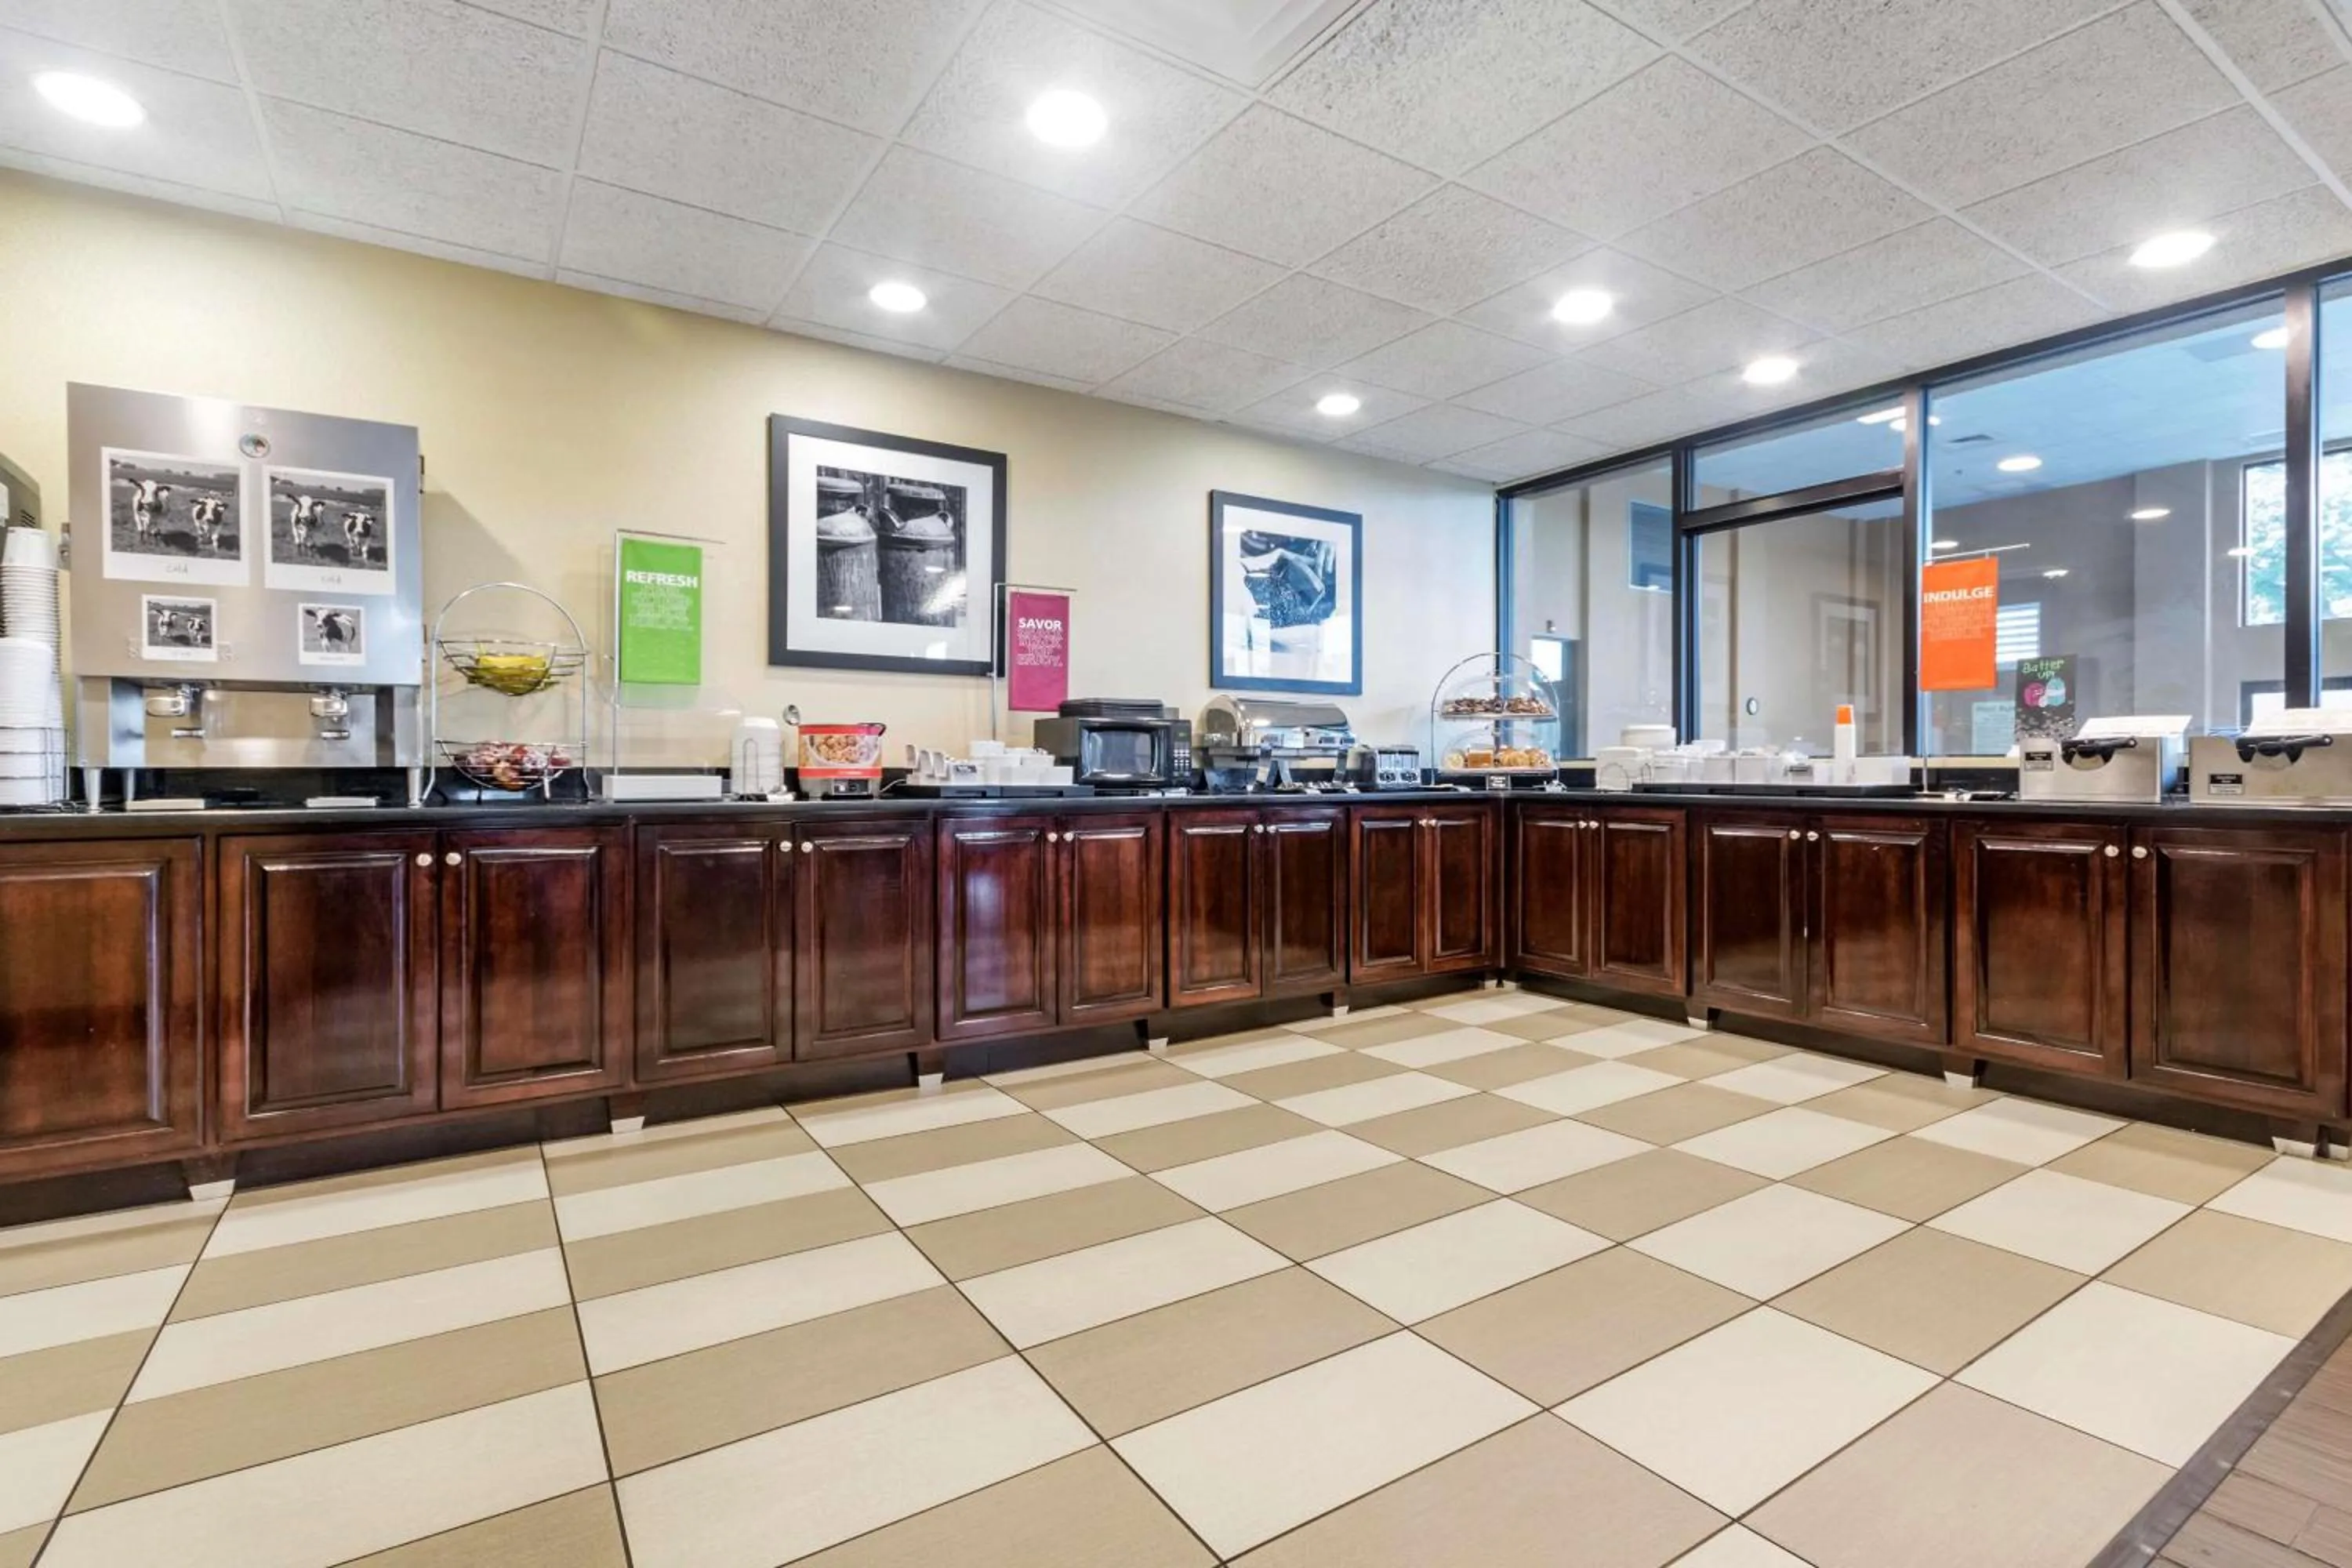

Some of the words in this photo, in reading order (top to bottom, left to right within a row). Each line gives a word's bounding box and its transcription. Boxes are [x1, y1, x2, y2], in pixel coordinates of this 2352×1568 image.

[626, 570, 698, 588] REFRESH
[1923, 586, 1995, 603] INDULGE
[1018, 617, 1062, 630] SAVOR
[2022, 659, 2065, 673] Batter
